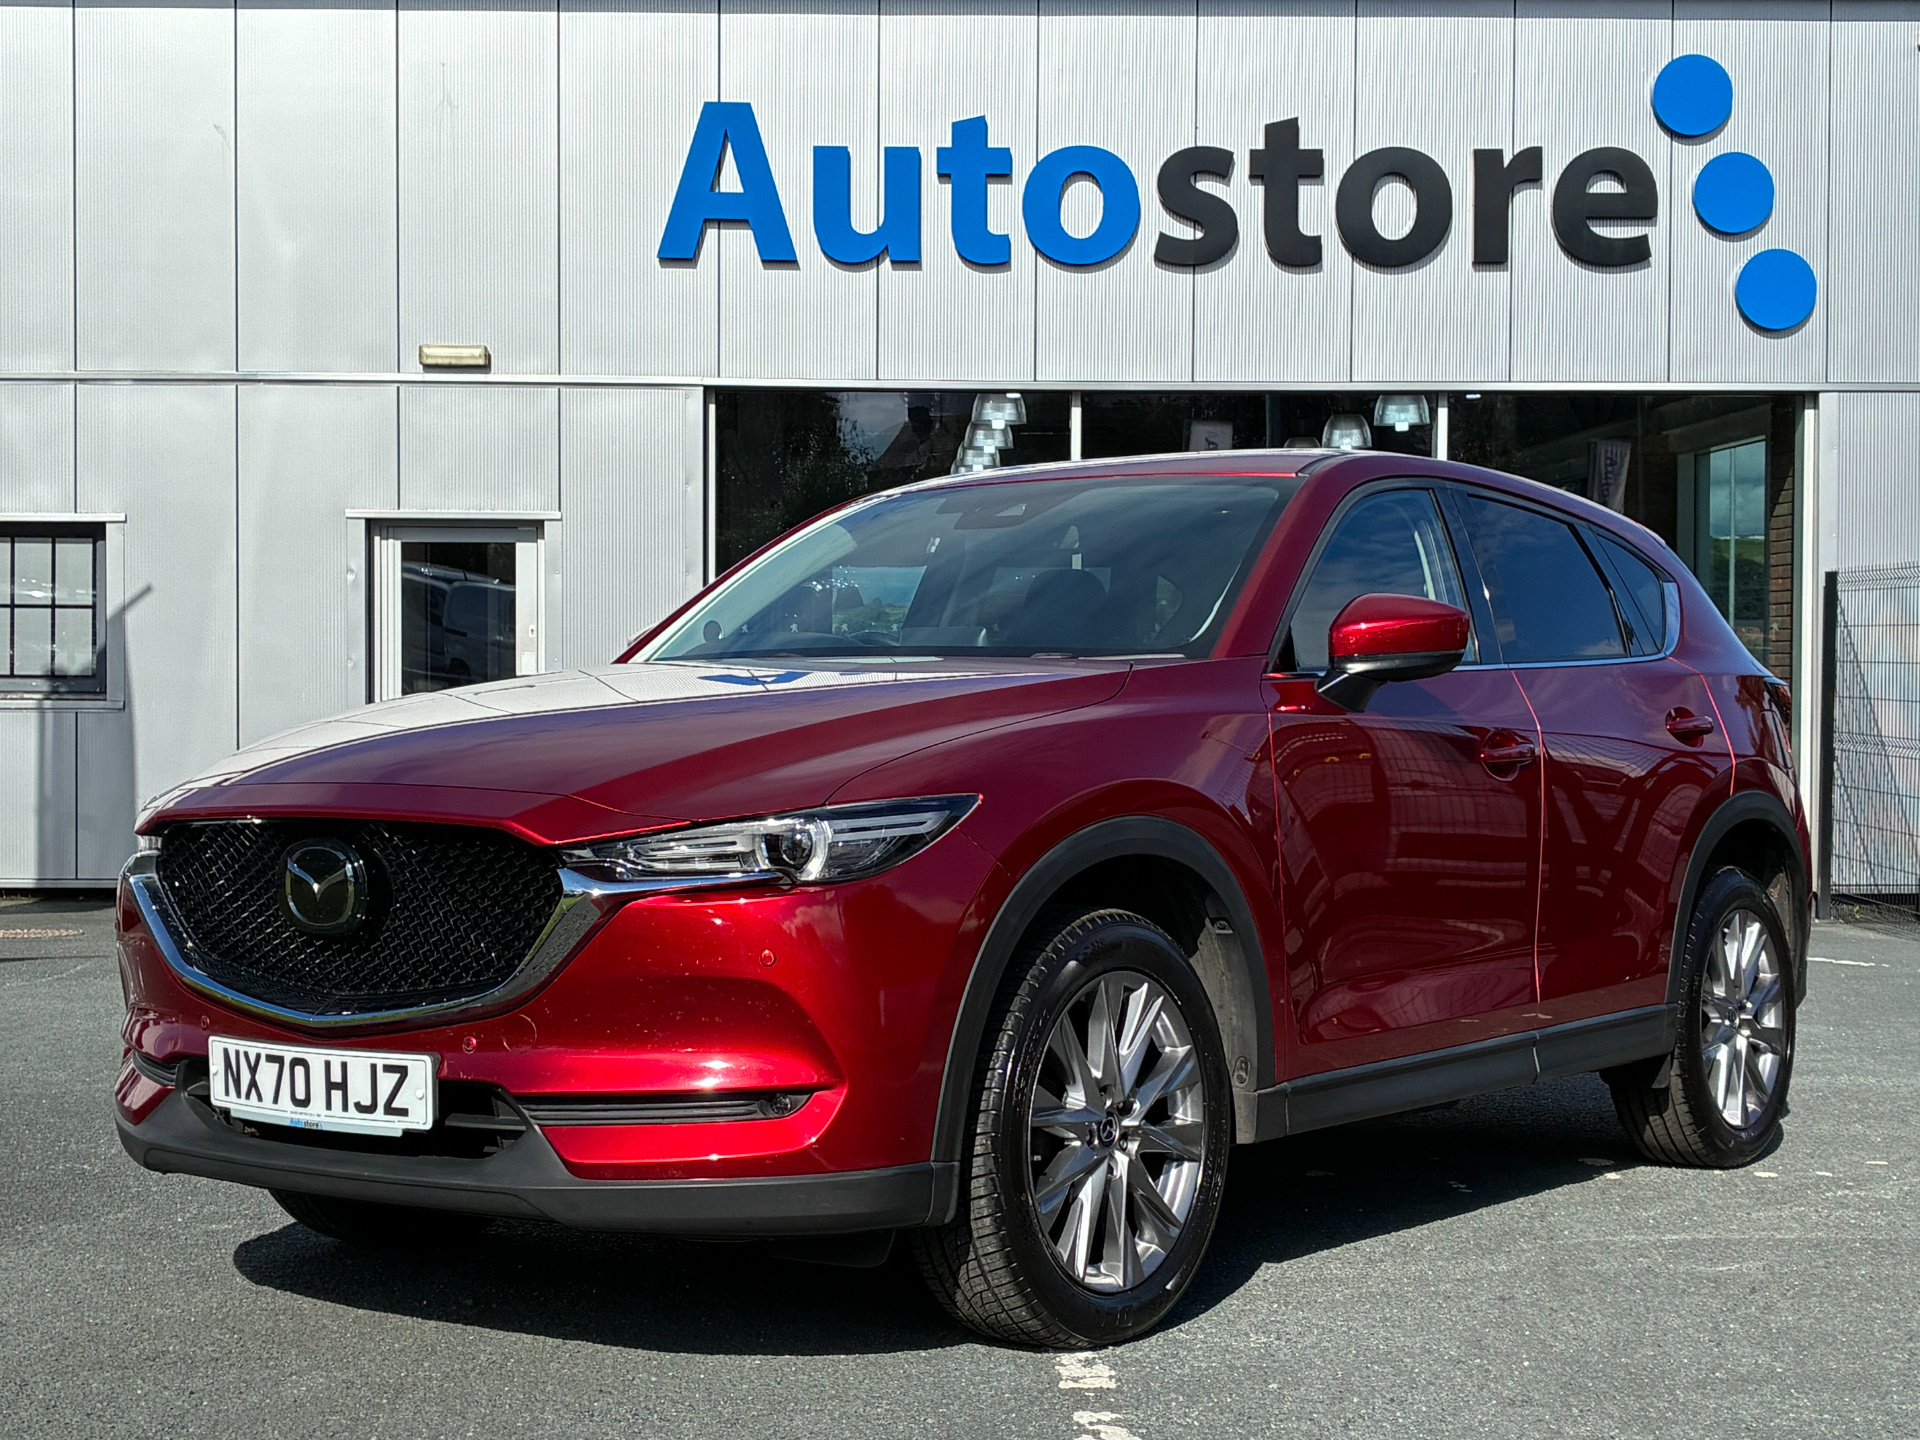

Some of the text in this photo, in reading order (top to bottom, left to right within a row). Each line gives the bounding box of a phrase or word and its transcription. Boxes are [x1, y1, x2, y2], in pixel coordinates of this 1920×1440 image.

[657, 101, 1658, 268] Autostore
[222, 1047, 409, 1118] NX70 HJZ
